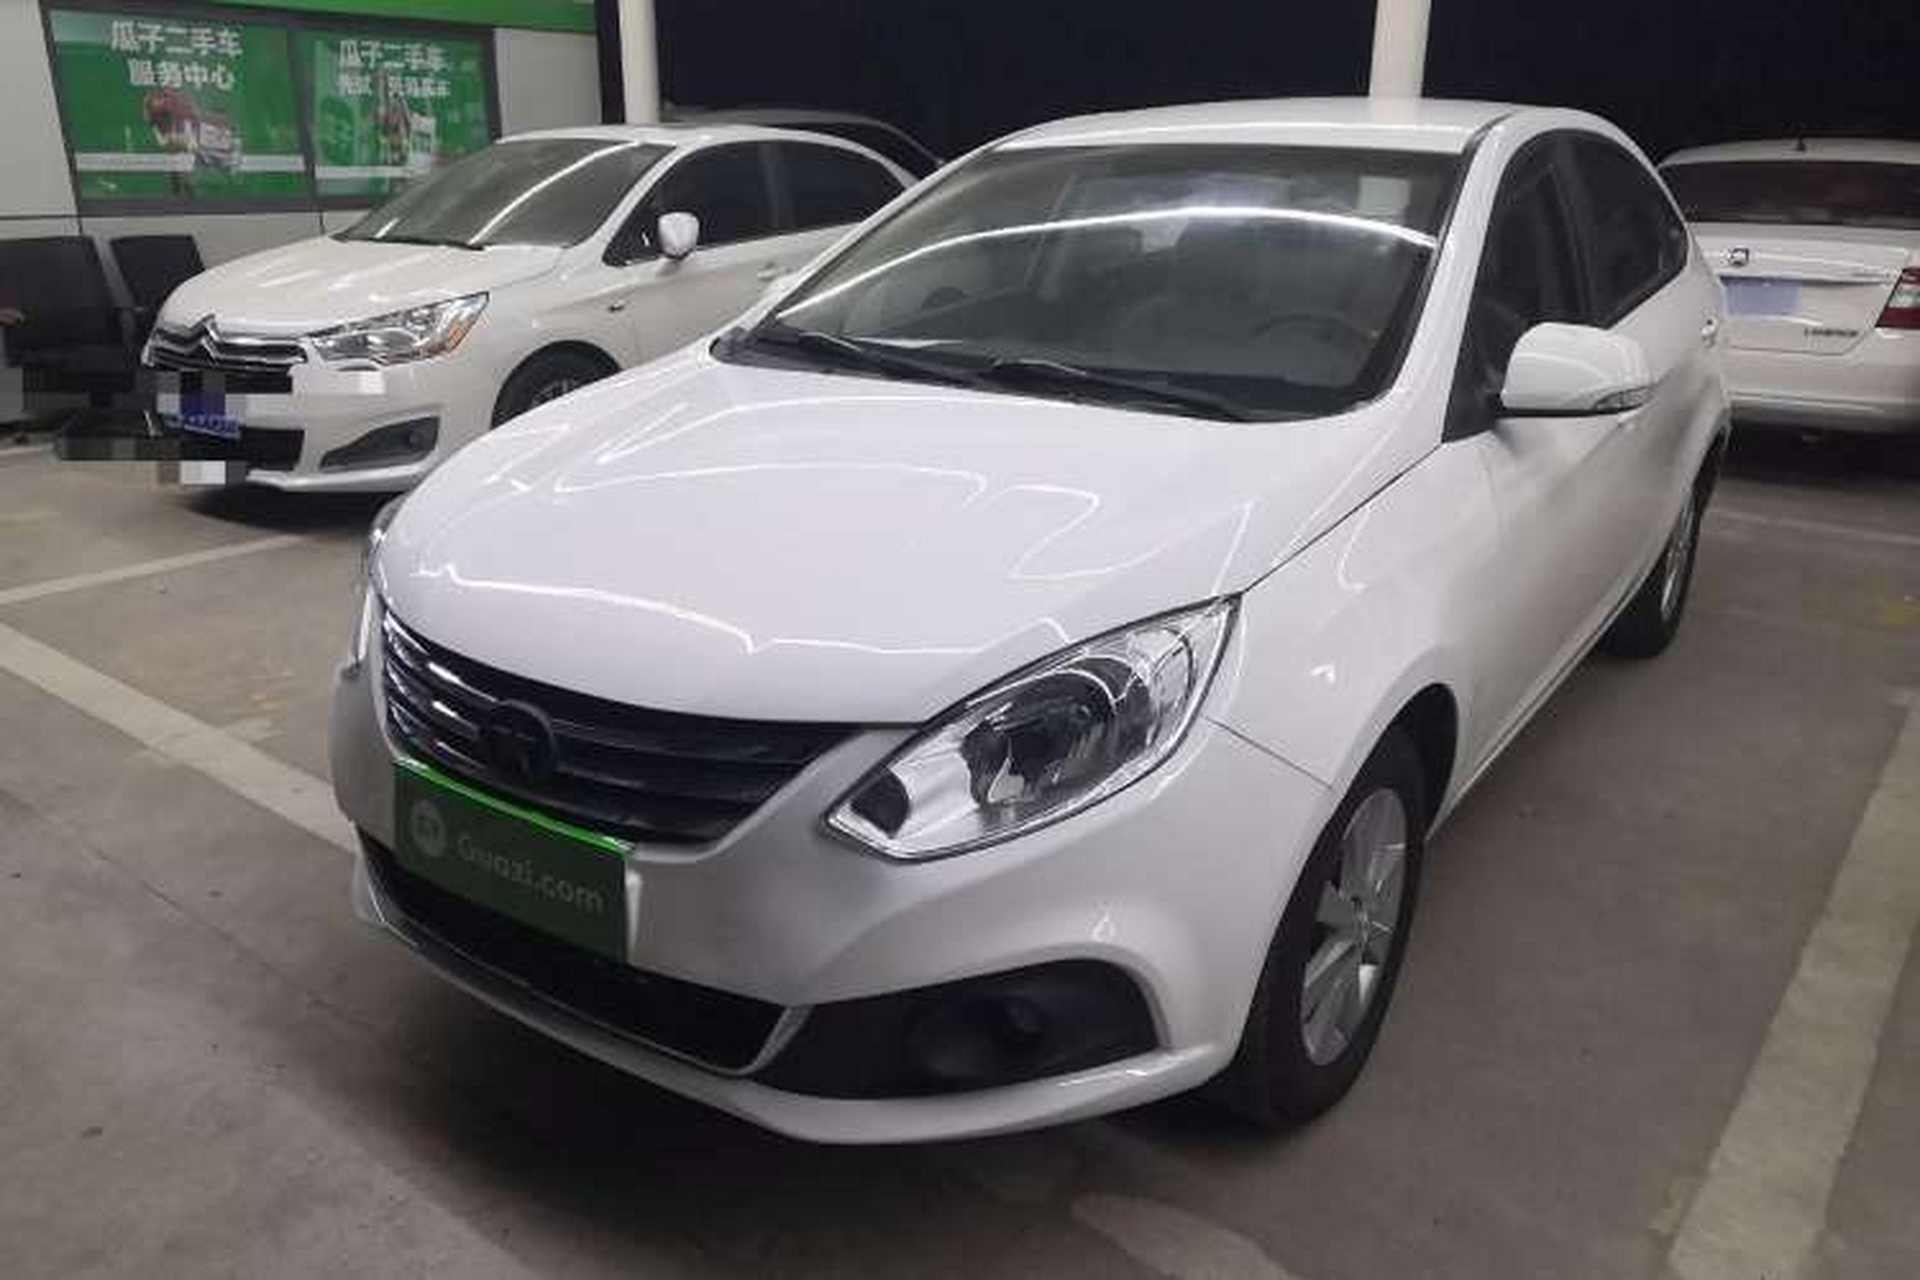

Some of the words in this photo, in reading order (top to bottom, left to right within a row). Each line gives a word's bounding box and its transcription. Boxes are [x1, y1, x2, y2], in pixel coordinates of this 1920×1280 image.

[111, 20, 243, 56] 瓜子二手车
[339, 39, 447, 72] 瓜子二手车
[128, 58, 235, 91] 服务中心
[457, 833, 606, 914] Guazi.com
